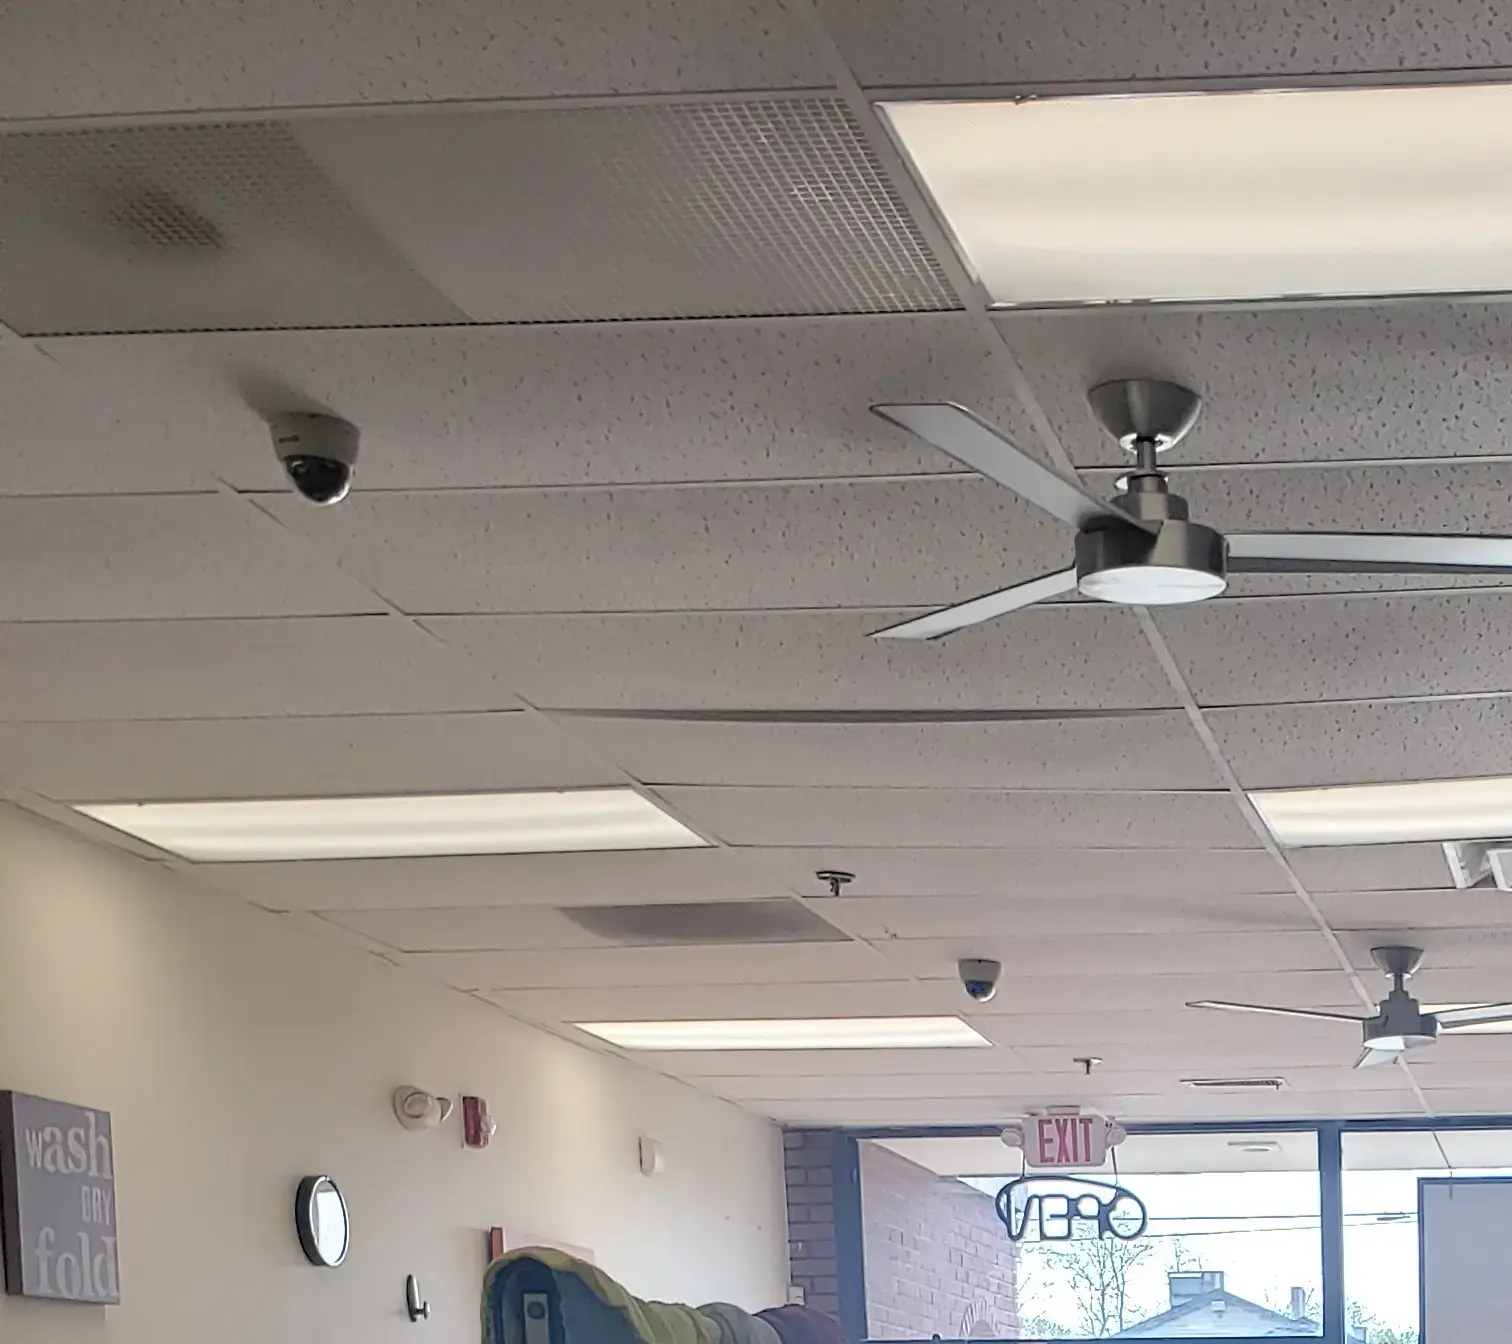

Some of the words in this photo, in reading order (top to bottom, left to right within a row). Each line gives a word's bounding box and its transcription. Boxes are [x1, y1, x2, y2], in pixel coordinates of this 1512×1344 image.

[25, 1111, 113, 1180] wash
[1037, 1117, 1093, 1164] EXIT
[80, 1185, 113, 1226] DRY
[35, 1226, 119, 1299] fold
